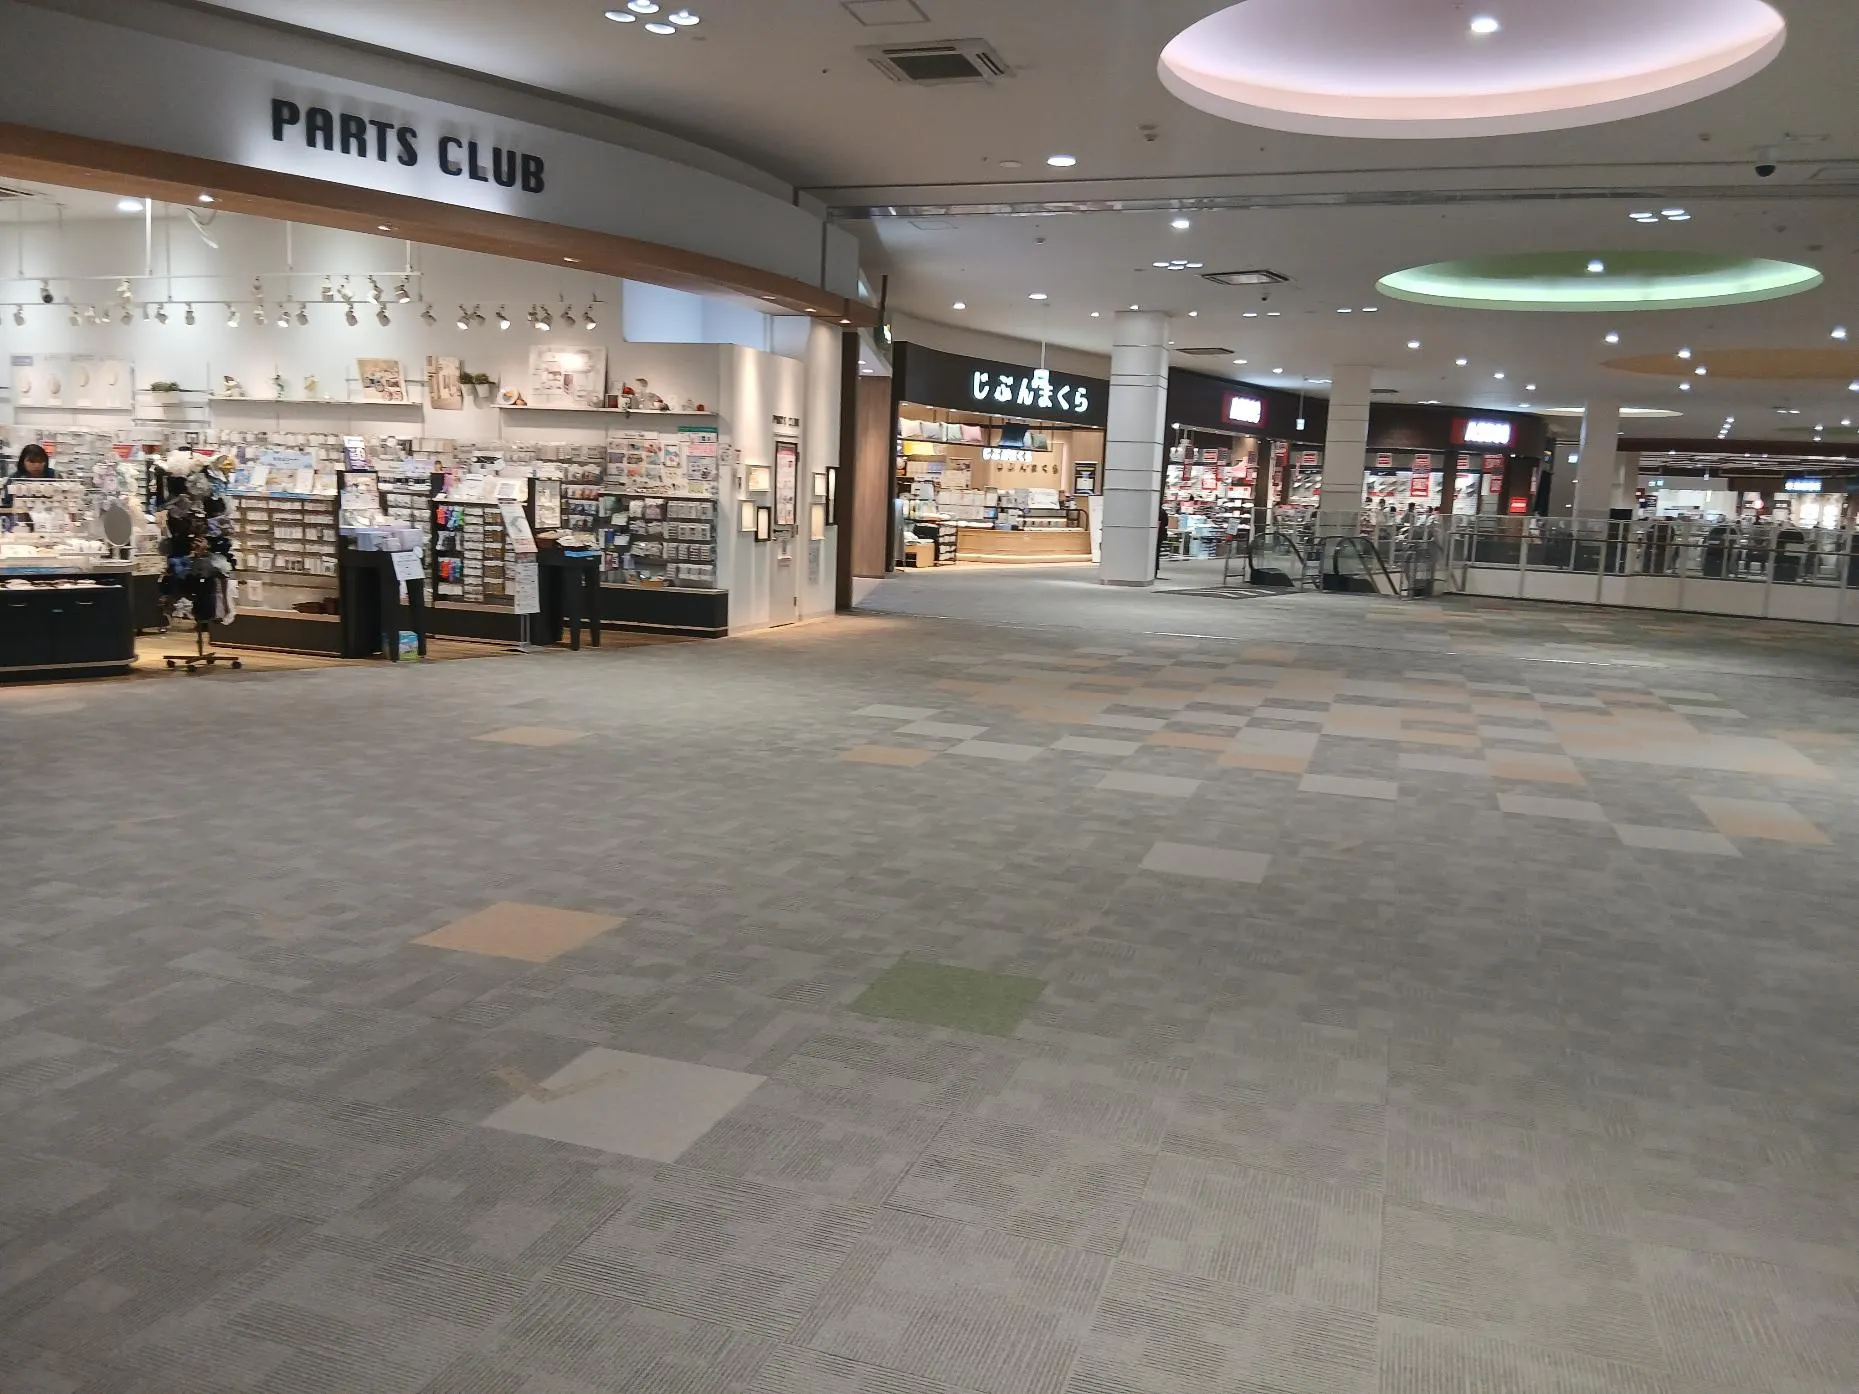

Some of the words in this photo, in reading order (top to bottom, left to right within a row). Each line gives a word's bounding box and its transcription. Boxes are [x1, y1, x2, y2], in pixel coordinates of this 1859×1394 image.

[272, 98, 418, 167] PARTS
[438, 135, 545, 194] CLUB
[973, 371, 1089, 413] じぶんまくら
